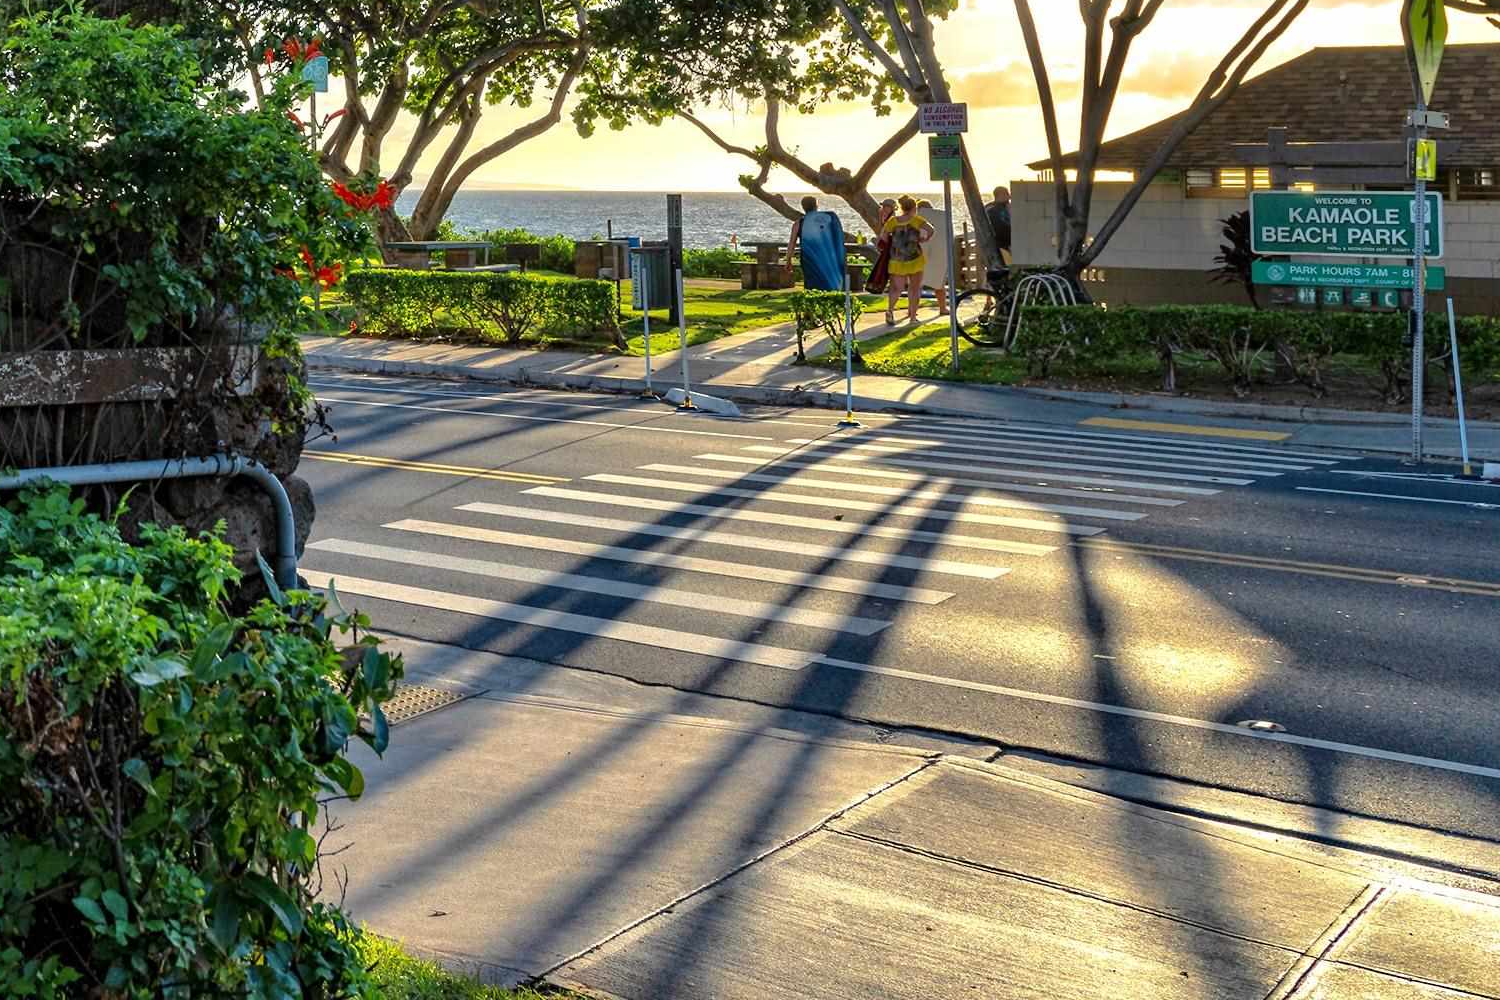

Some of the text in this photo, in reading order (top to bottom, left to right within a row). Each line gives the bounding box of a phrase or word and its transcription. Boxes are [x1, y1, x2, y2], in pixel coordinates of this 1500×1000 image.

[1289, 207, 1400, 225] KAMAOLE
[1261, 226, 1337, 243] BEACH
[1347, 228, 1408, 245] PARK
[1289, 265, 1317, 275] PARK
[1322, 267, 1362, 276] HOURS
[1365, 268, 1389, 277] 7AM
